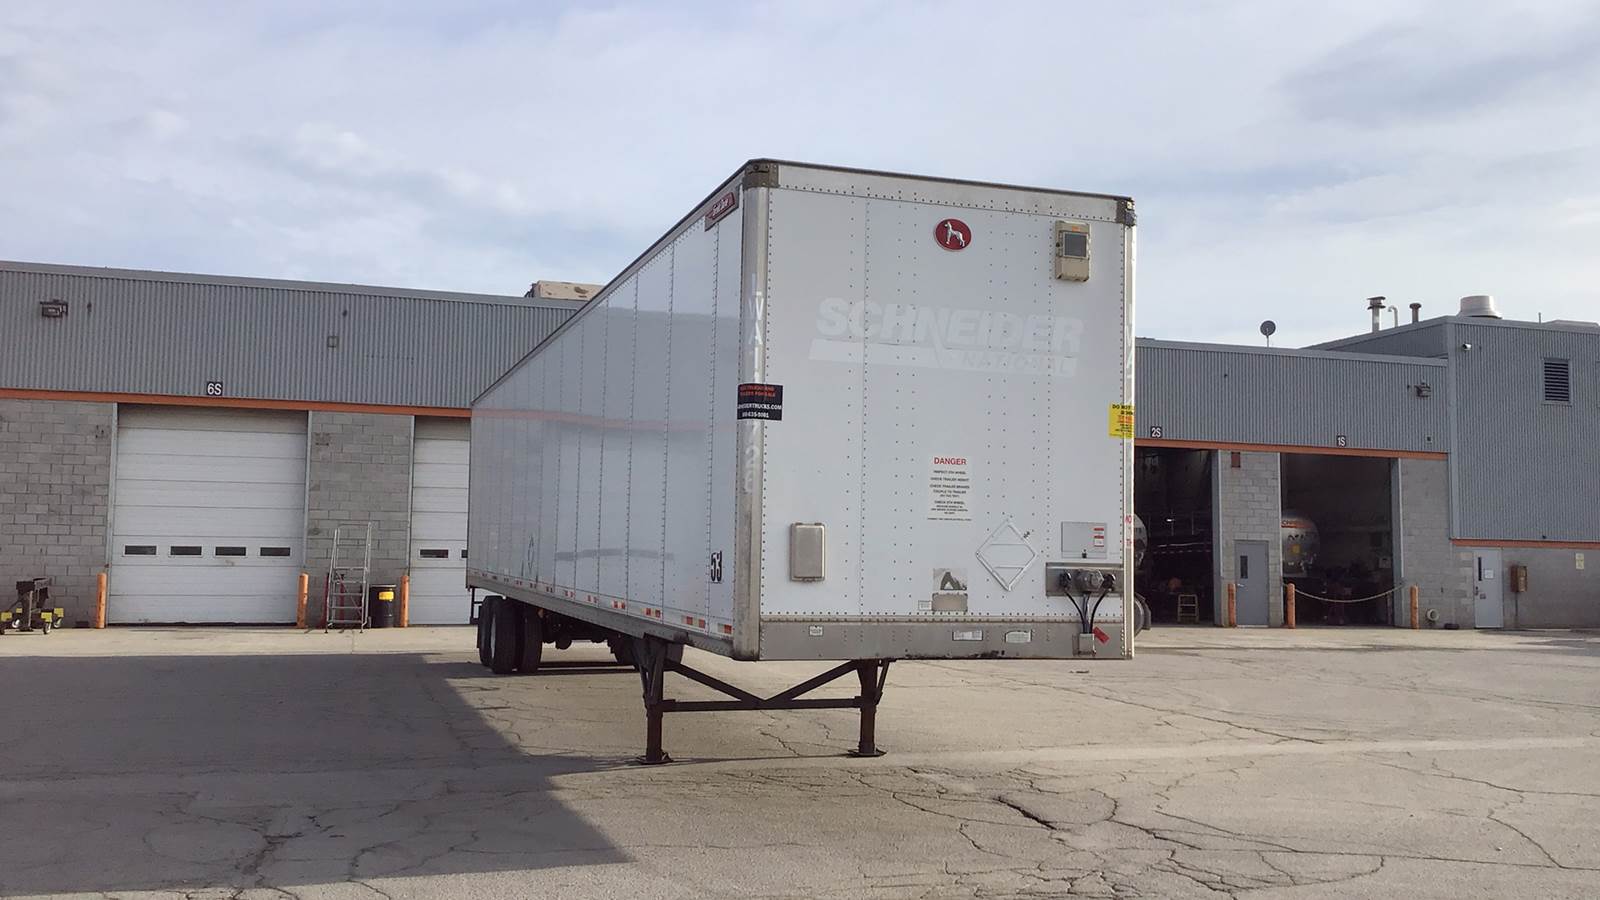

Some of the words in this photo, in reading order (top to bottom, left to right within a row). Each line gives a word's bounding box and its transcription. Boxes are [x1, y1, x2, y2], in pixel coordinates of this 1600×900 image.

[816, 297, 1085, 351] SCHNEIDER
[207, 382, 222, 395] 6S
[1151, 427, 1161, 438] 2S
[1337, 436, 1346, 447] 1S
[933, 457, 967, 465] DANGER
[711, 550, 722, 582] 53
